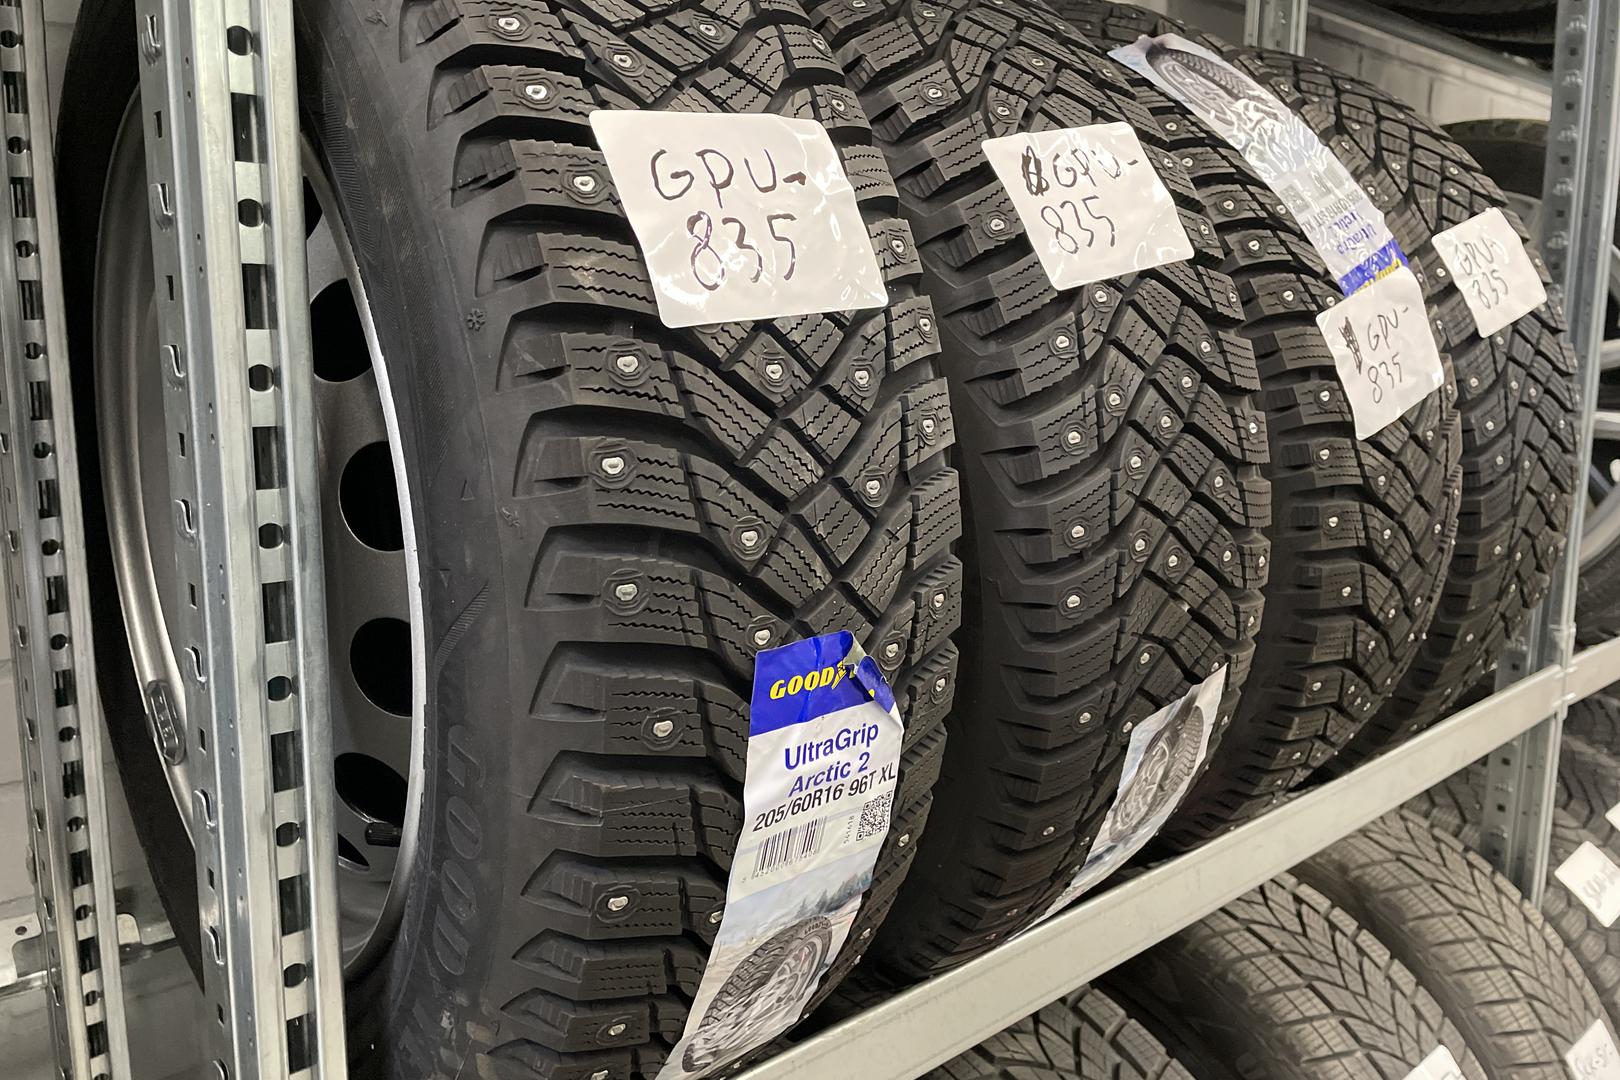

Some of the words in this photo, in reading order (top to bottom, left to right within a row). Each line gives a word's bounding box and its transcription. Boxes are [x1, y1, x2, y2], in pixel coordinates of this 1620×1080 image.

[651, 148, 807, 208] GPU-
[1040, 194, 1116, 254] 835
[687, 211, 797, 291] 835
[1472, 269, 1509, 310] 835
[1367, 306, 1409, 351] GPU-
[1367, 351, 1402, 404] 835
[769, 660, 847, 700] GOOD
[784, 722, 880, 771] UltraGrip
[752, 783, 845, 832] 205/60R16
[847, 769, 878, 796] 96T
[878, 761, 897, 785] XL
[787, 760, 851, 798] Arctic
[857, 751, 871, 773] 2
